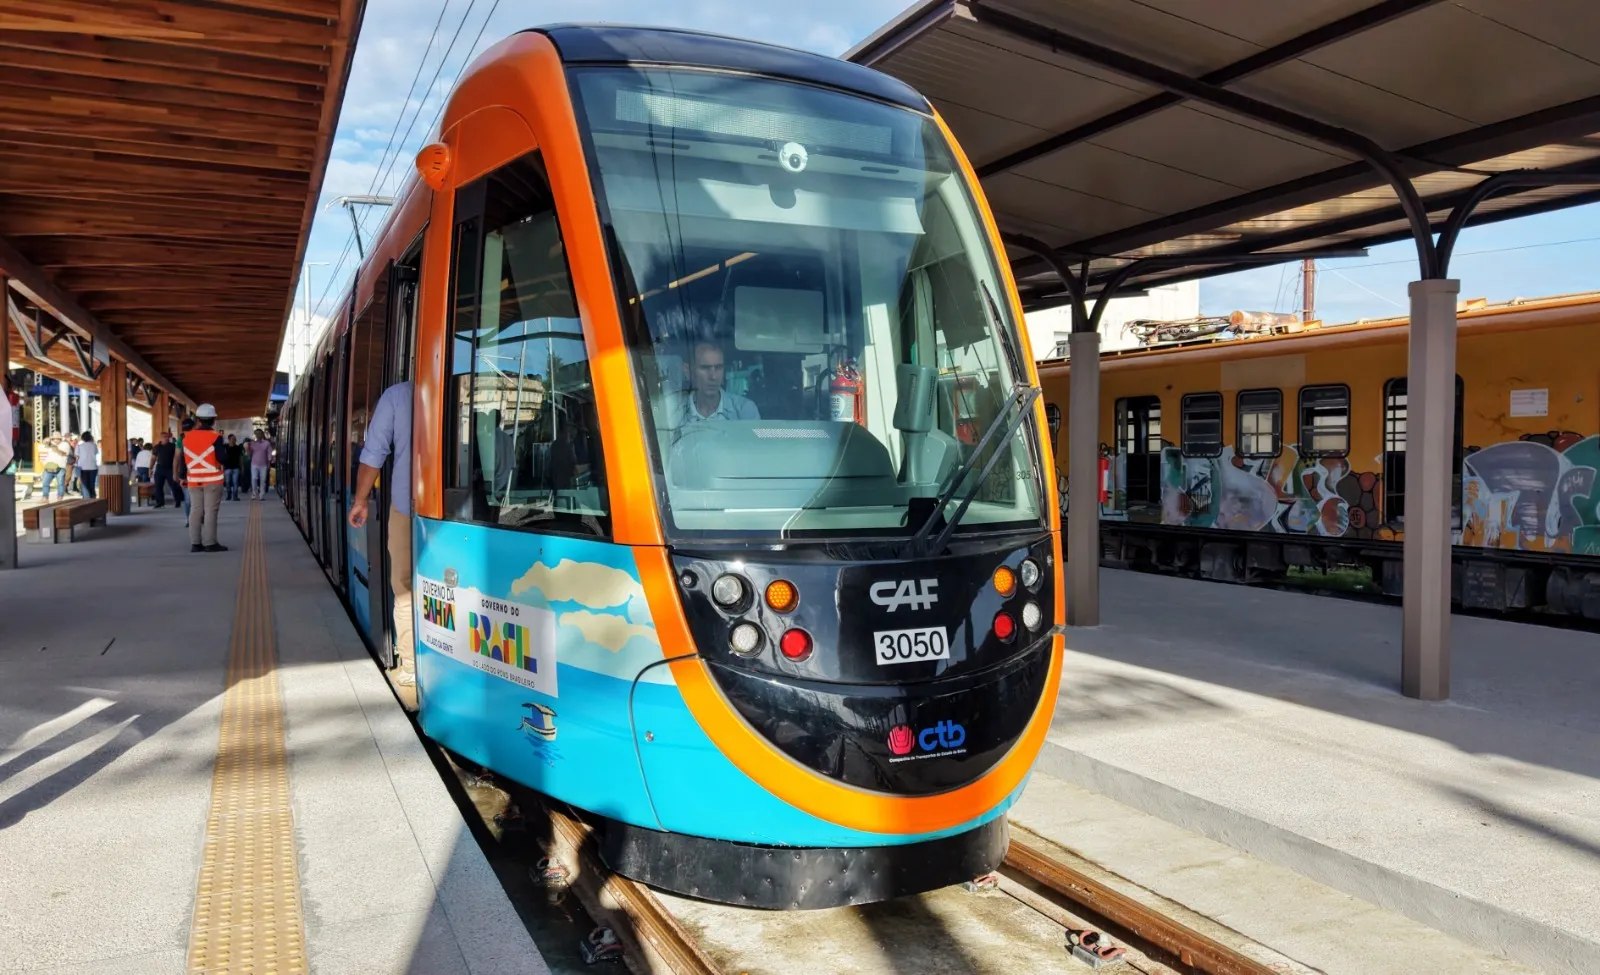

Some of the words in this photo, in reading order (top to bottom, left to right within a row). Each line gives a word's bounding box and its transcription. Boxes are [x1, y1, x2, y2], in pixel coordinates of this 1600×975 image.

[422, 580, 446, 600] GOVERNO
[446, 587, 455, 602] DA
[869, 578, 939, 613] CAF
[423, 594, 456, 632] BAHIA
[481, 599, 508, 614] GOVERNO
[510, 606, 520, 616] DO
[469, 611, 538, 674] BRASIL
[879, 630, 945, 660] 3050
[918, 719, 966, 751] ctb
